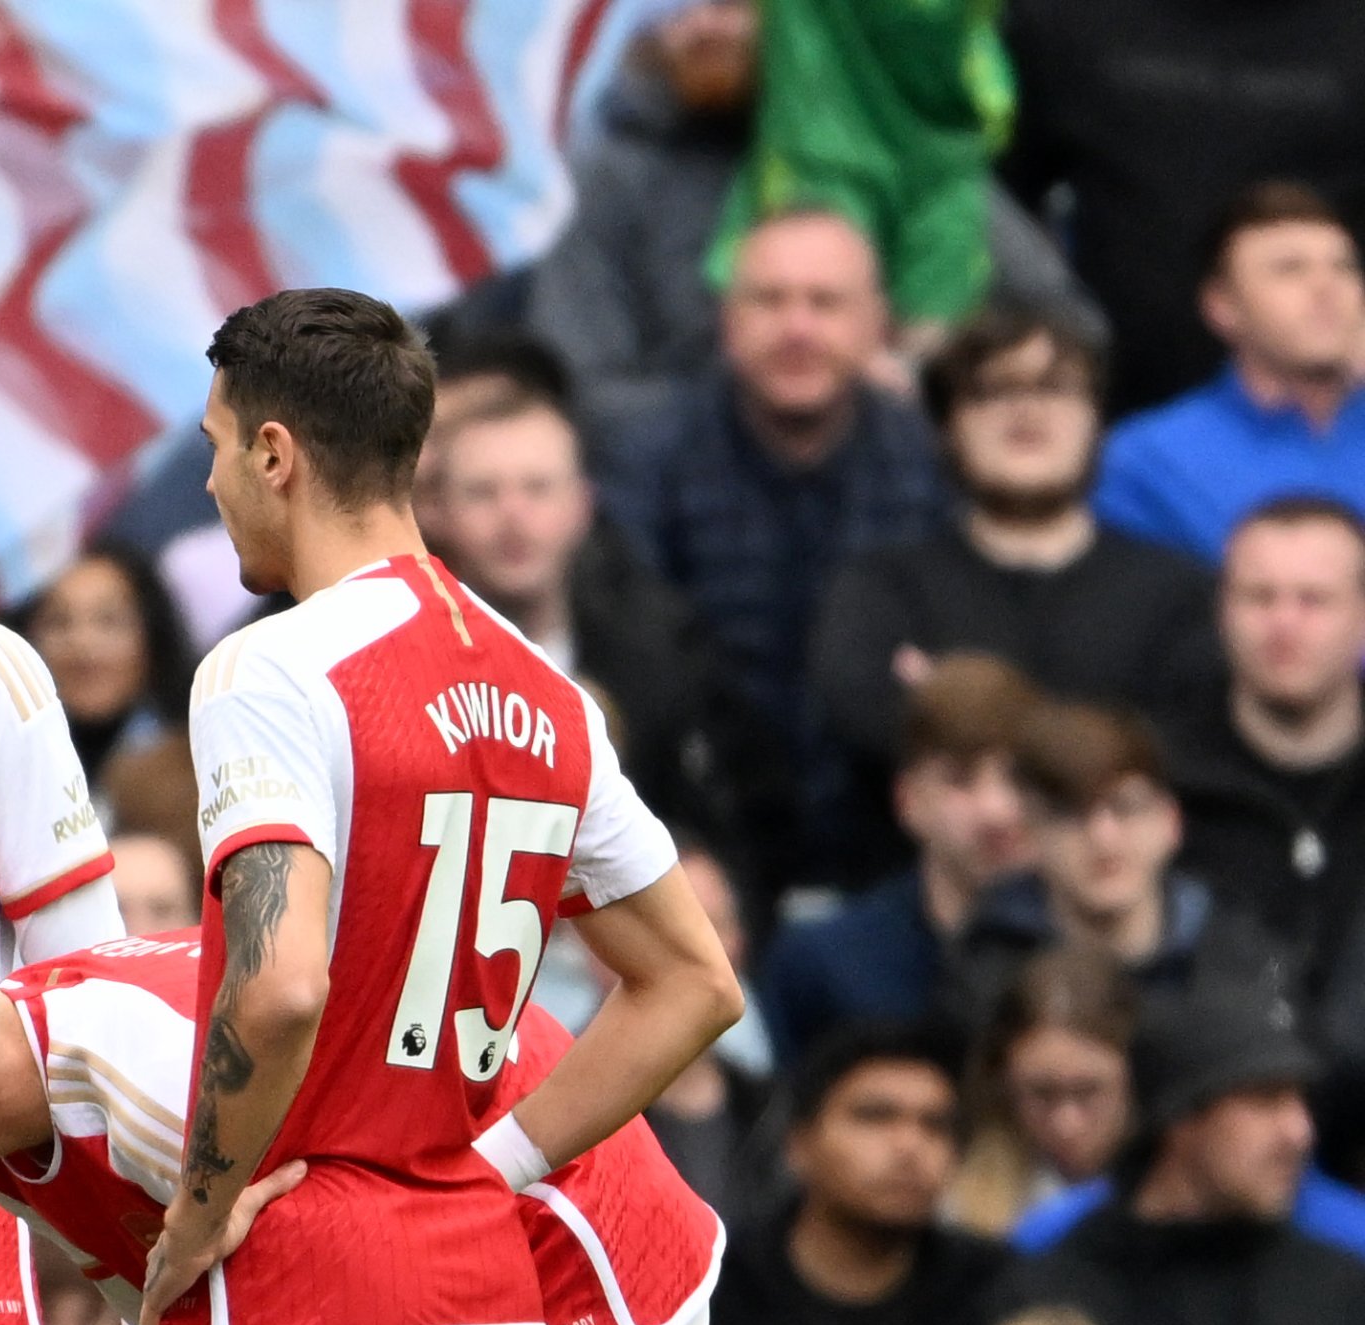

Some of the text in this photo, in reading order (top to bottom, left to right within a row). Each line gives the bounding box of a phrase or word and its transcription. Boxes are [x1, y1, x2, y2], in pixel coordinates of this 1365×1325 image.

[424, 681, 556, 769] KIWIOR
[201, 778, 303, 832] RWANDA
[211, 756, 269, 789] VISIT
[385, 791, 580, 1083] 15
